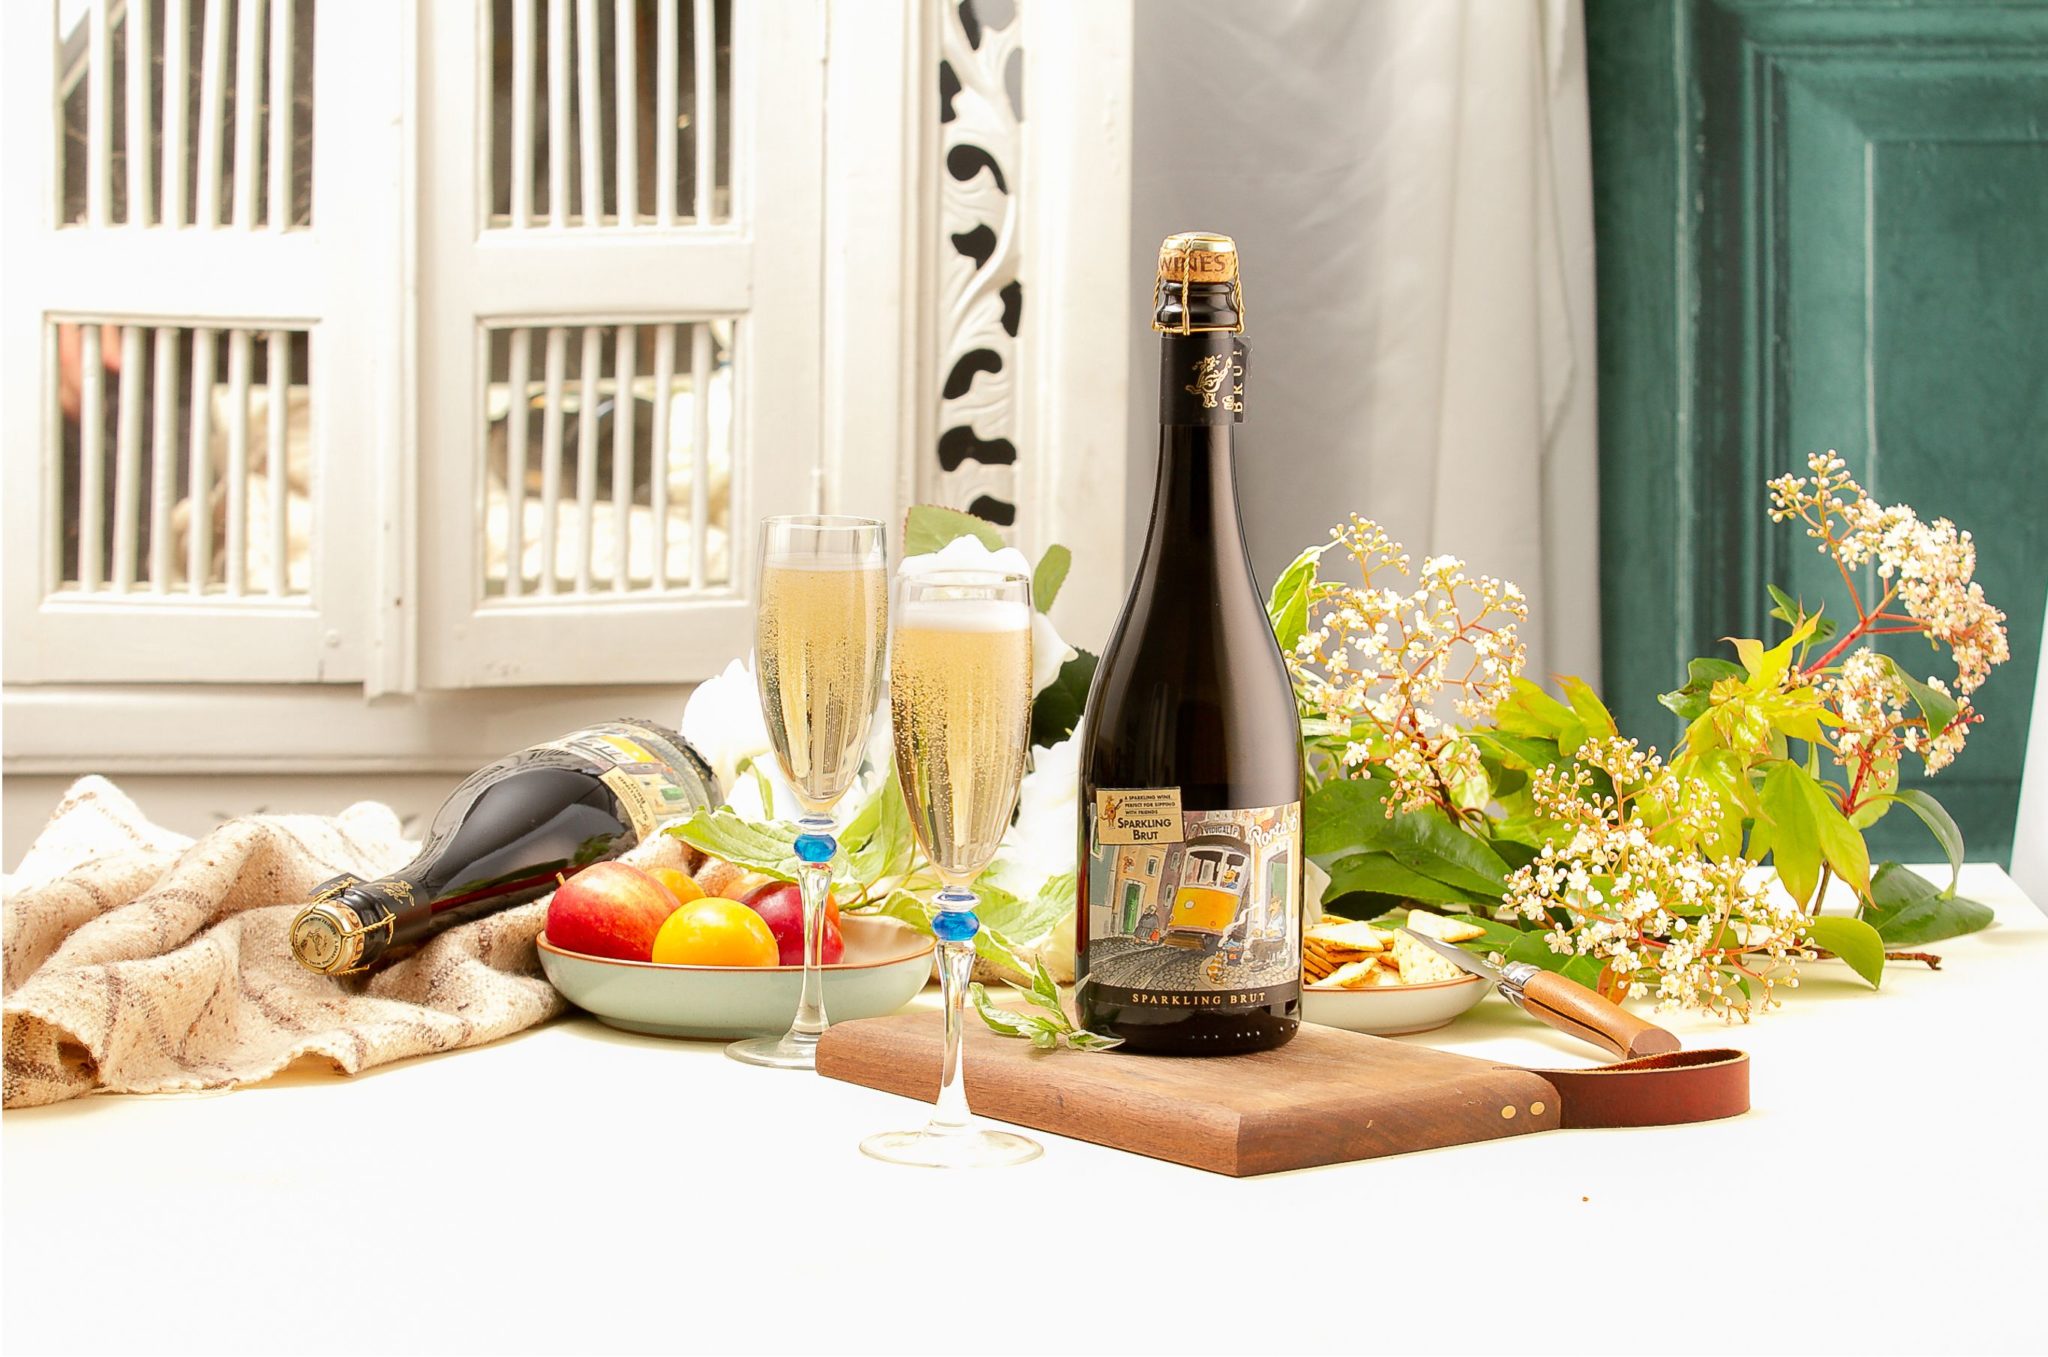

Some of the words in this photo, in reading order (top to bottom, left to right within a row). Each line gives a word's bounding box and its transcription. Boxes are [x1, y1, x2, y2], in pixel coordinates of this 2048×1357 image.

[1161, 254, 1225, 273] WINES
[1117, 817, 1172, 829] SPARKLING
[1132, 829, 1159, 841] BRUT
[1132, 993, 1221, 1006] SPARKLING
[1230, 992, 1266, 1005] BRUT
